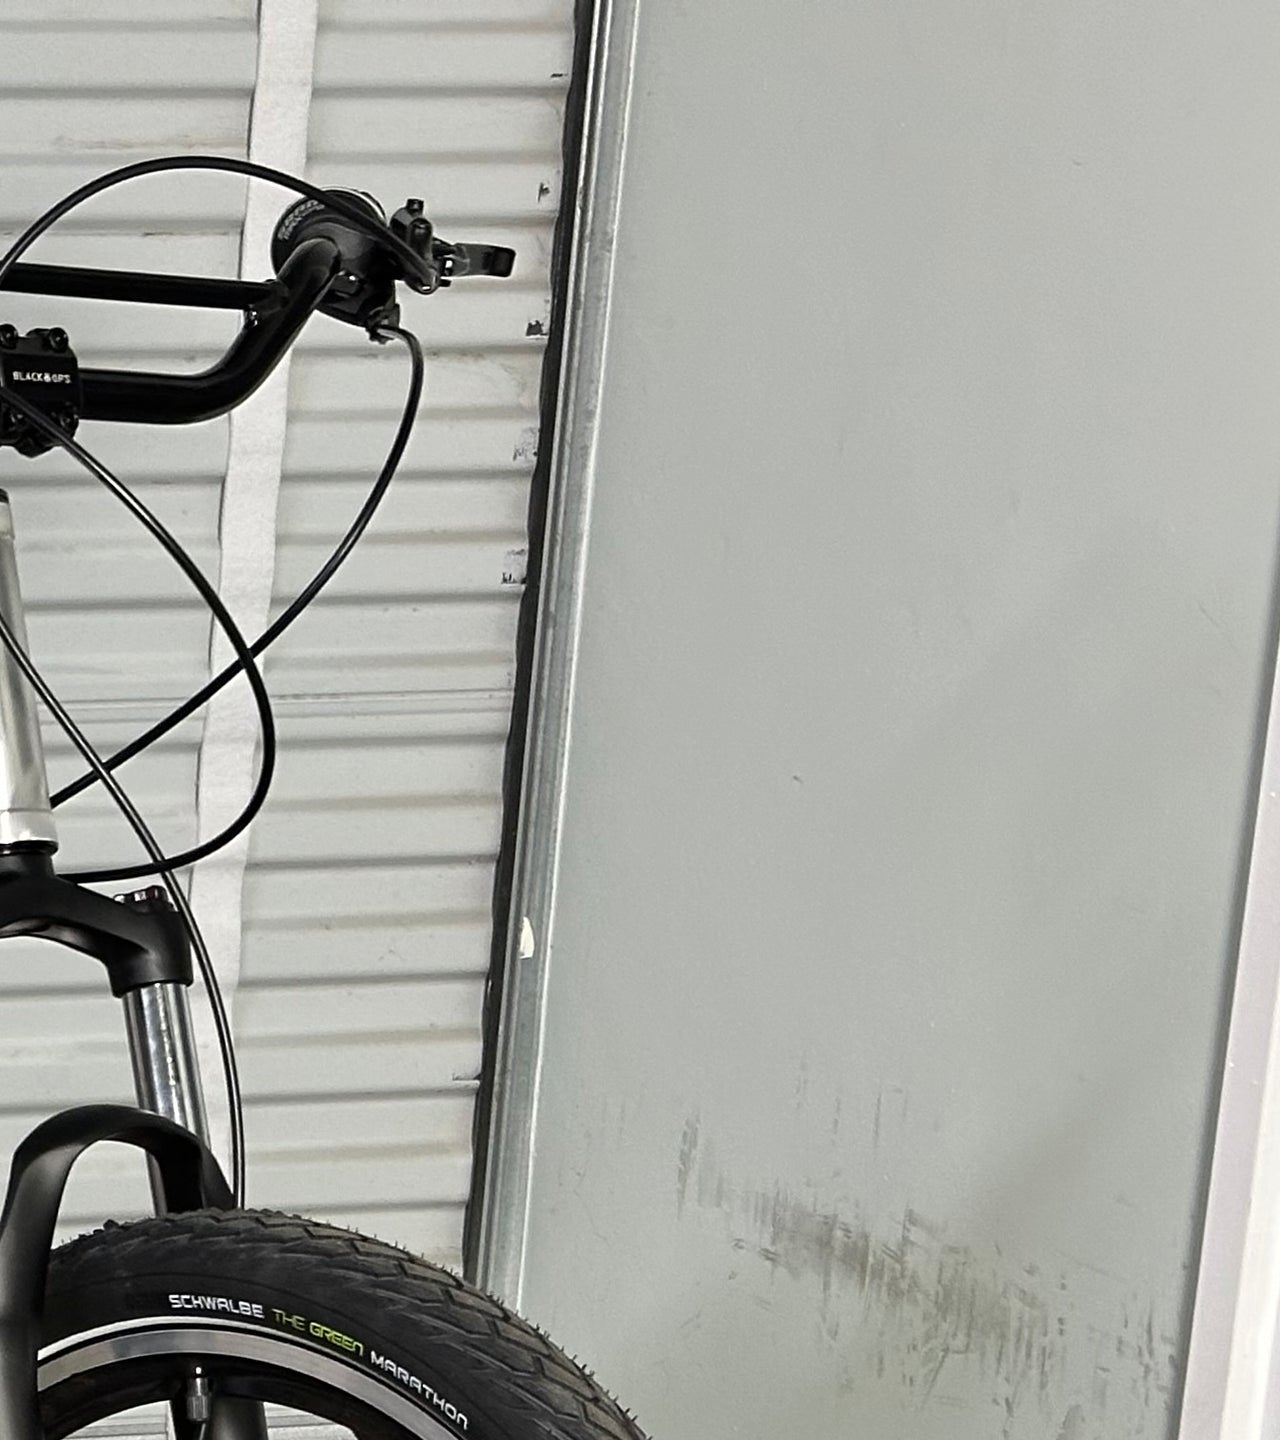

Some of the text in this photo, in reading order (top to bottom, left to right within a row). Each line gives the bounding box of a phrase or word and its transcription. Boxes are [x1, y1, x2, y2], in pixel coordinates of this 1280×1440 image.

[169, 1294, 468, 1430] SCHWALBE THE GREEN MARATHON
